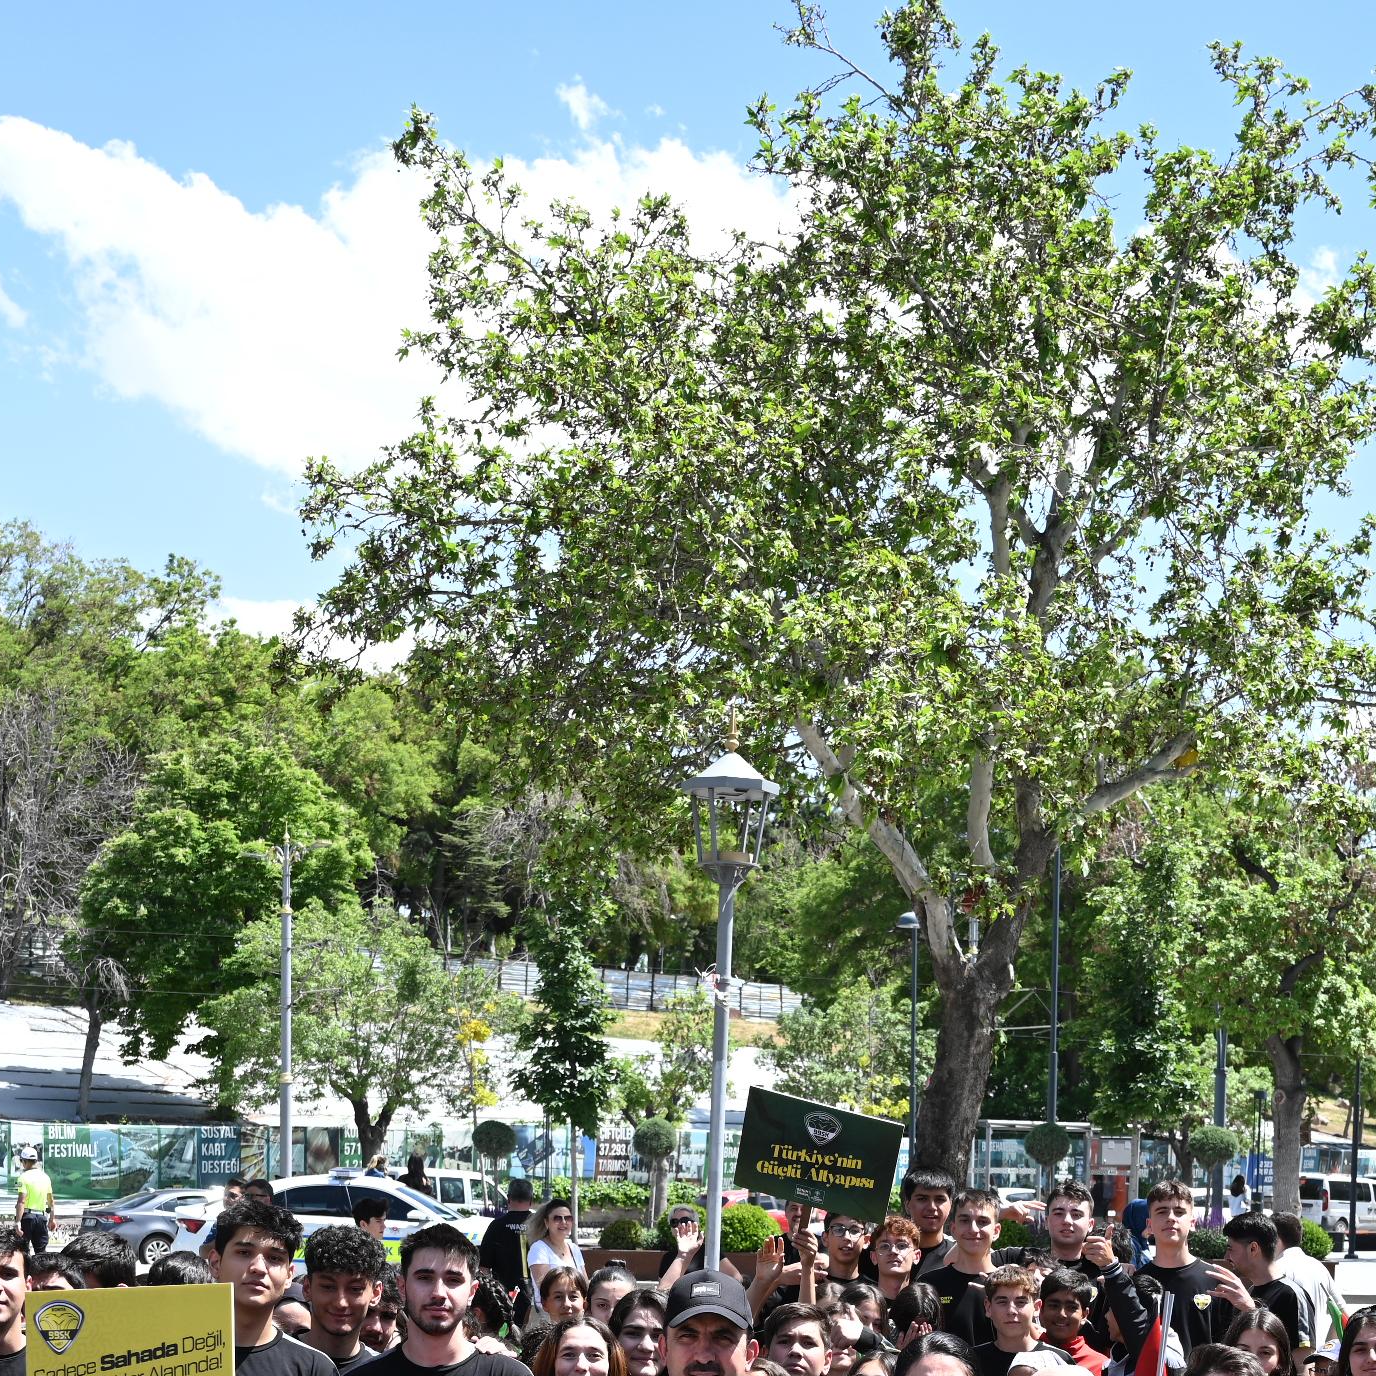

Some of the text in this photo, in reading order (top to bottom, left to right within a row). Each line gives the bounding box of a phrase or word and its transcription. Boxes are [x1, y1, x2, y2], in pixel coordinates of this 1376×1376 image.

[48, 1142, 98, 1158] FESTİVALİ
[202, 1143, 227, 1156] KART
[771, 1144, 862, 1170] Türkiye'nin
[202, 1158, 240, 1174] DESTEĞİ
[756, 1160, 875, 1190] Güçlü Altyapısı
[100, 1342, 178, 1371] Sahada
[182, 1330, 226, 1354] Değil,
